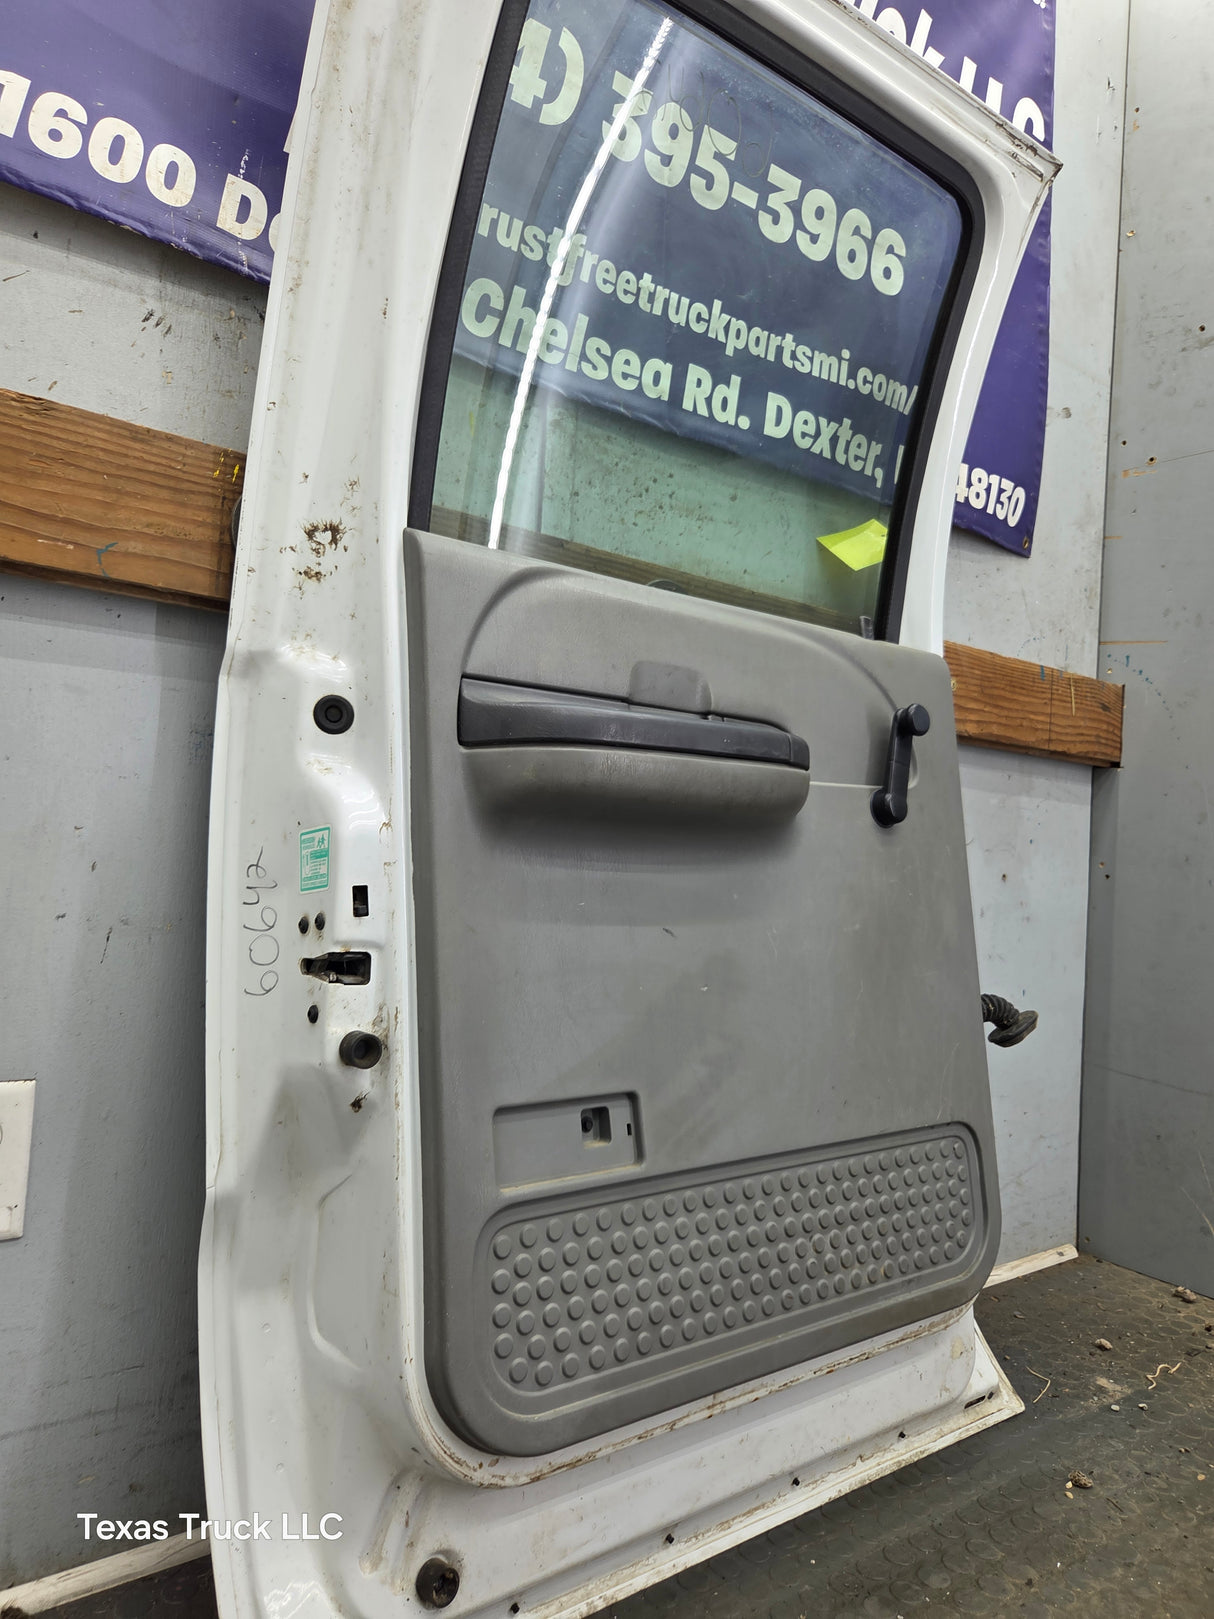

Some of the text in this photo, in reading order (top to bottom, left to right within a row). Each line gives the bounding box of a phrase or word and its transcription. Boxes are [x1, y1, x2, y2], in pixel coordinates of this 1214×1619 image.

[602, 70, 906, 296] 395-3966
[0, 70, 197, 208] 1600
[461, 277, 673, 401] Chelsea
[682, 362, 751, 431] Rd.
[763, 391, 884, 488] Dexter,
[955, 462, 1026, 528] 48130
[242, 845, 280, 996] 60642
